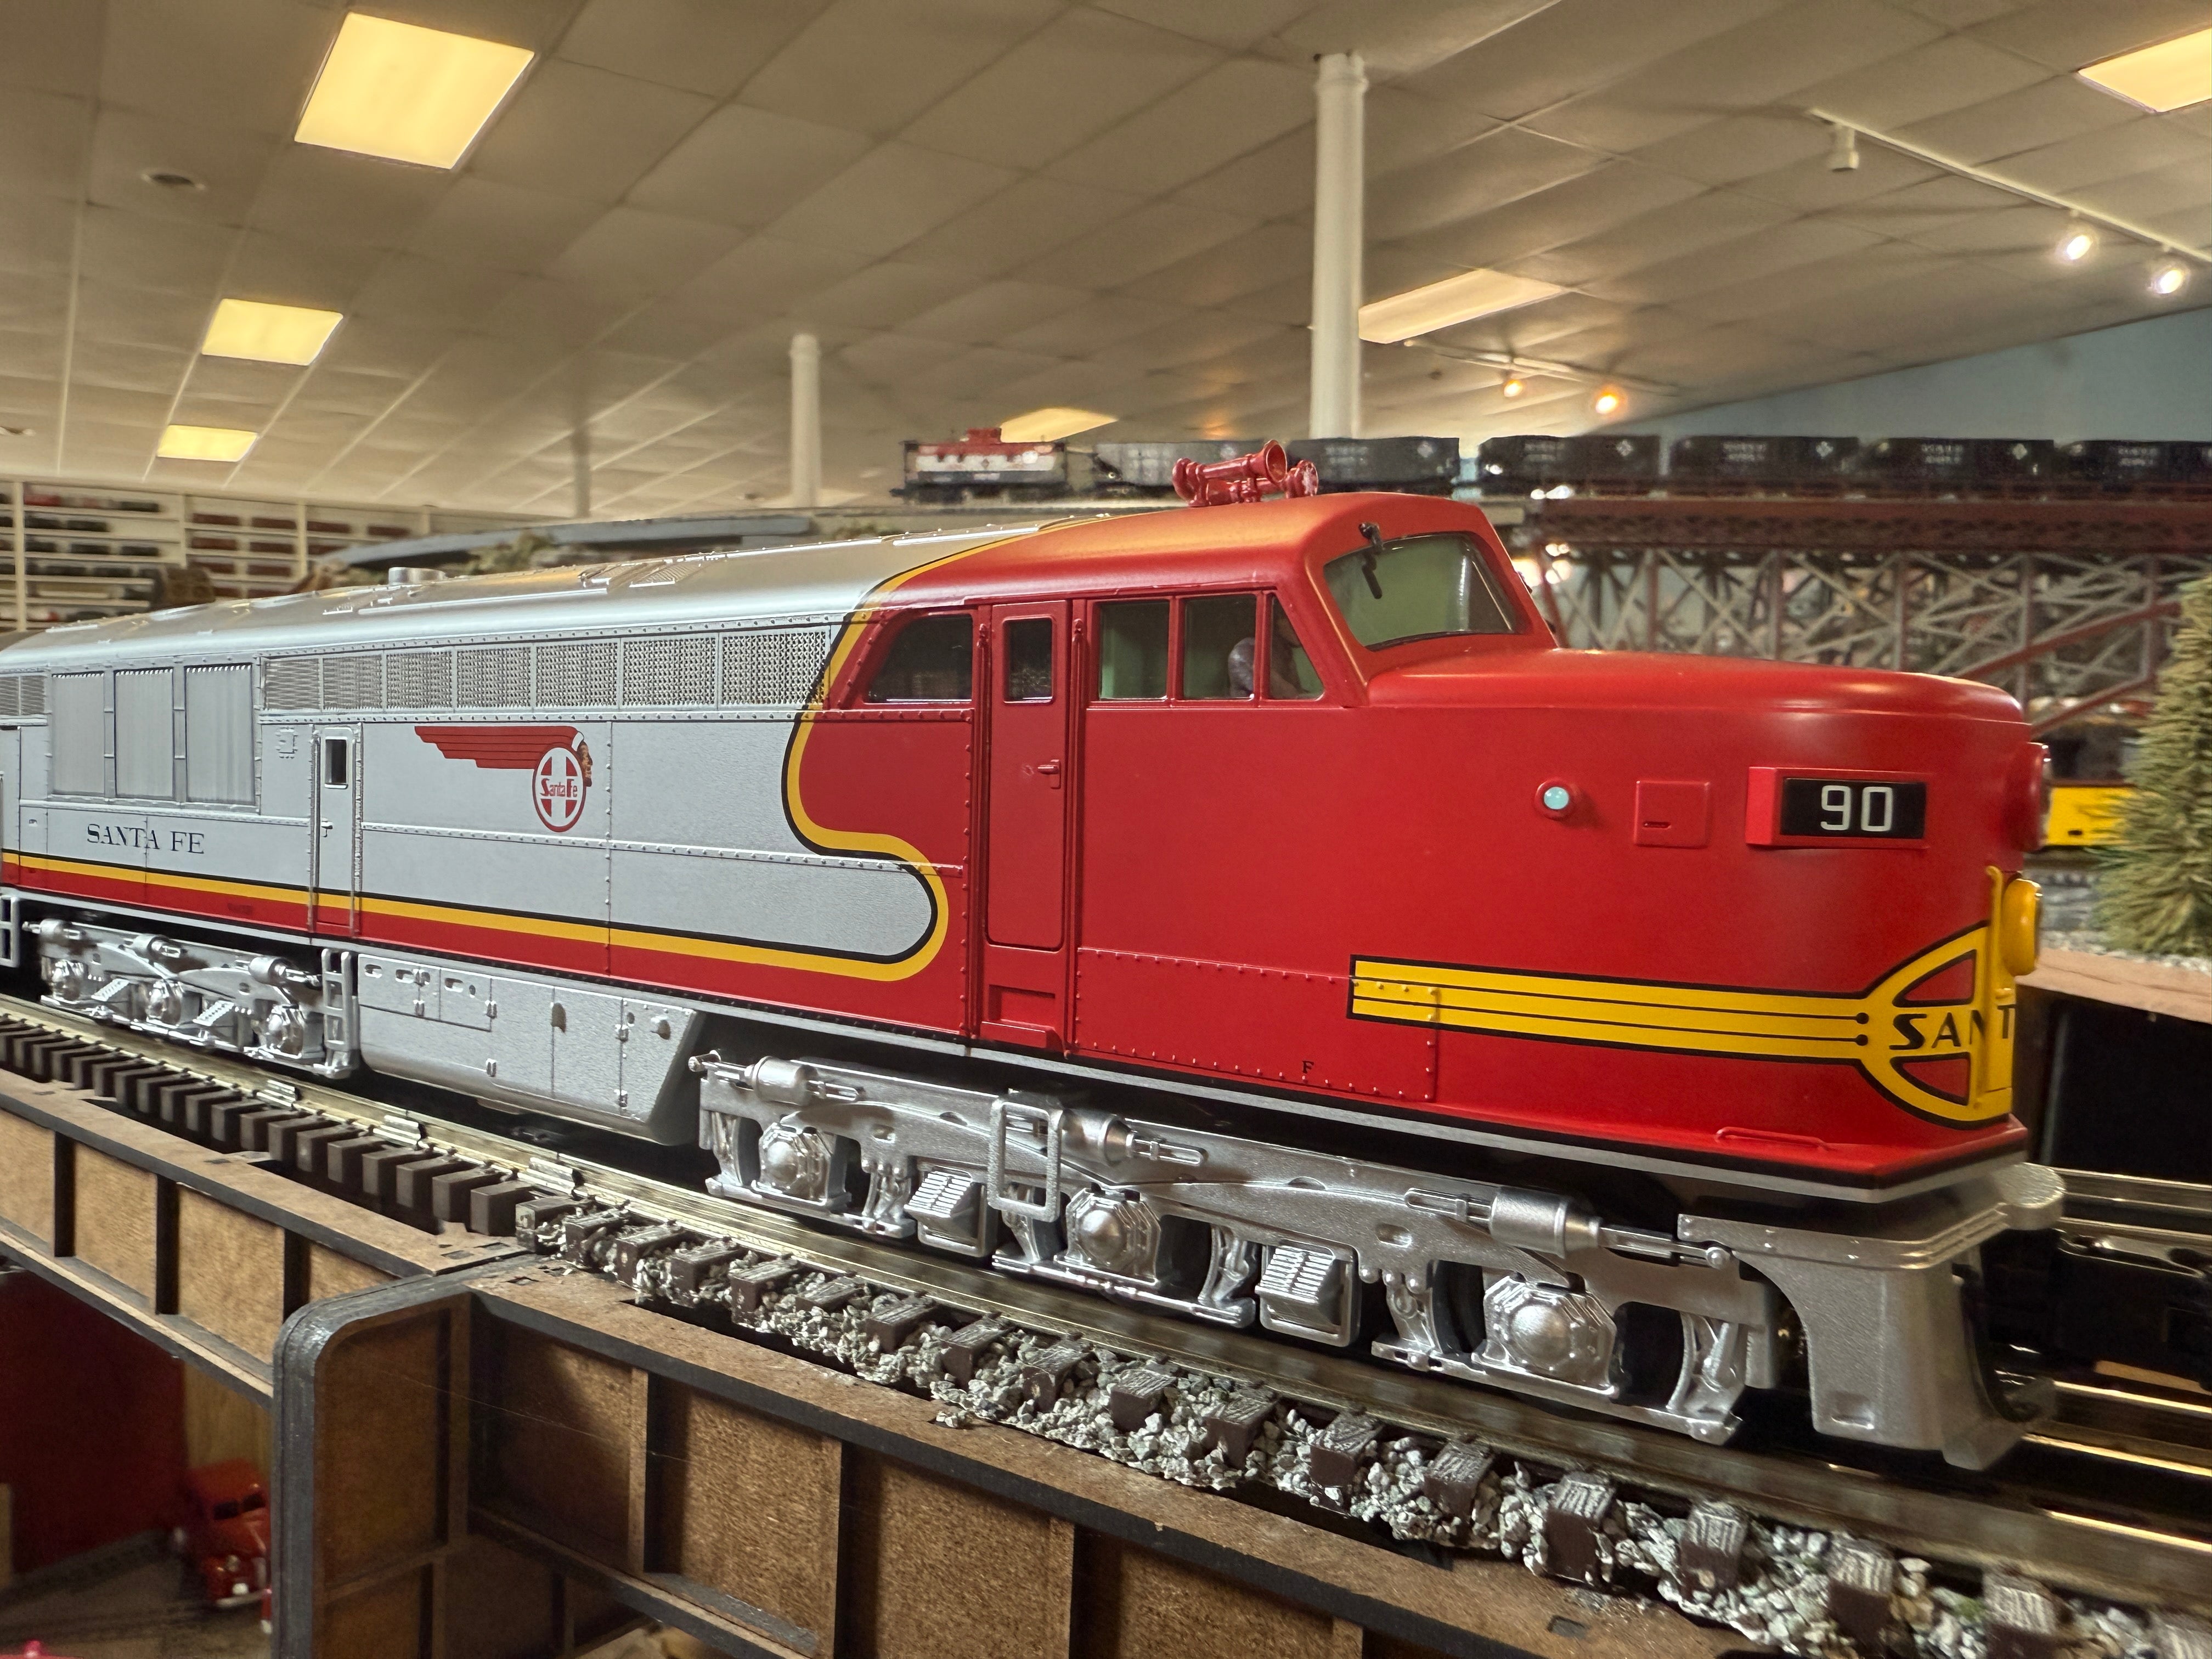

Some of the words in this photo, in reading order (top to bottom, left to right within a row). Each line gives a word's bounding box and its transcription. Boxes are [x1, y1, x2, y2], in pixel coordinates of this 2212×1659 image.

[540, 778, 566, 797] Santa
[566, 778, 578, 797] Fe
[1820, 785, 1893, 832] 90
[87, 824, 160, 849] SANTA
[170, 831, 205, 854] FE
[1302, 1060, 1314, 1074] F
